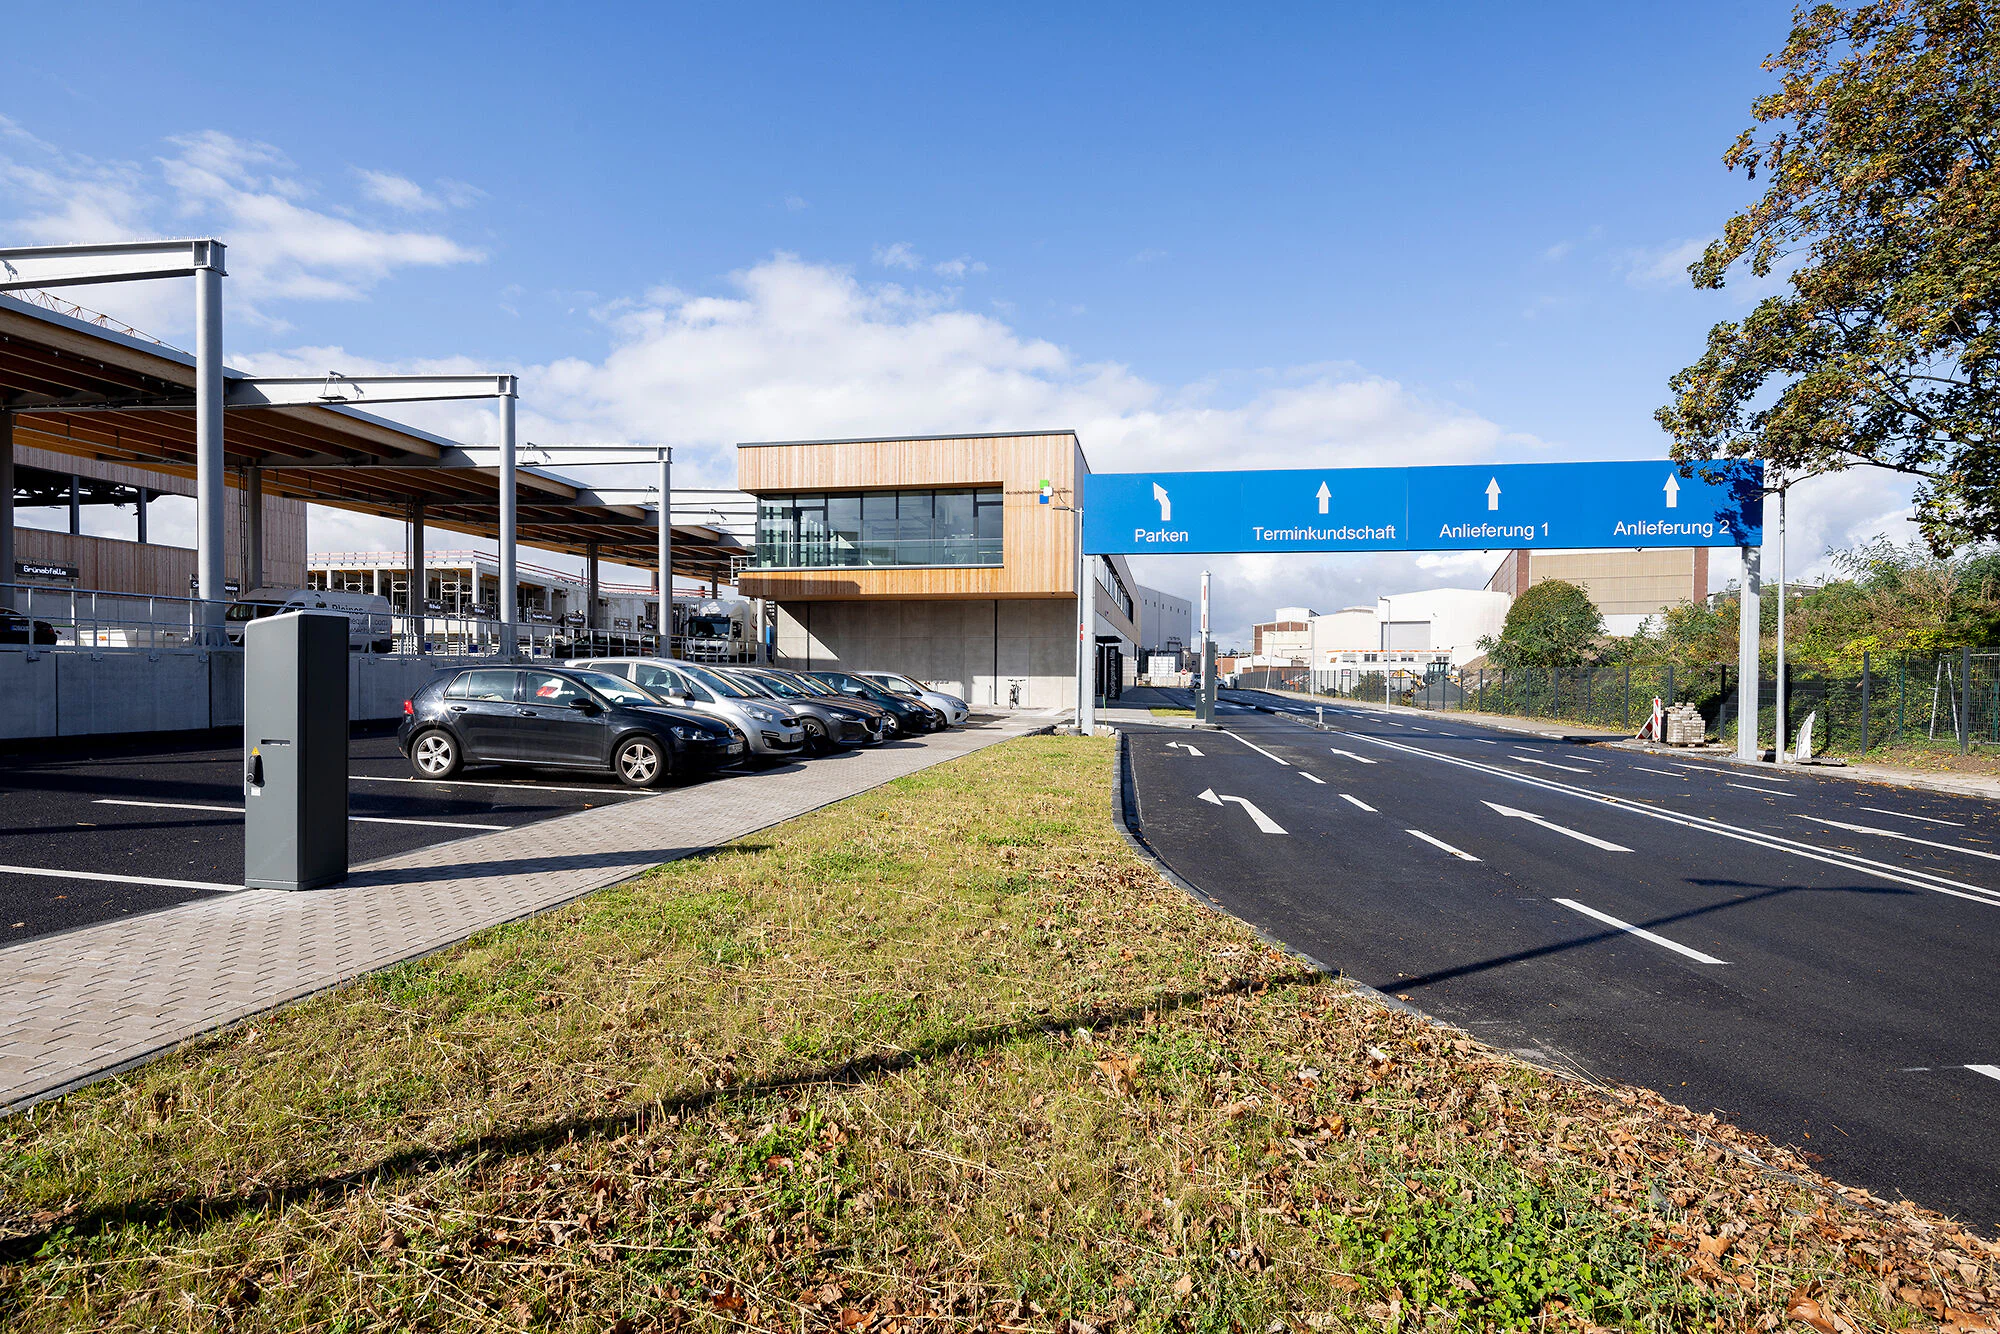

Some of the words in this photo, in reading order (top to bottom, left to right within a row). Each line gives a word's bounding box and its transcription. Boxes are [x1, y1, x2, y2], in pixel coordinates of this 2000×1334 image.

[1134, 528, 1189, 543] Parken
[1252, 525, 1396, 541] Terminkundschaft
[1439, 522, 1535, 541] Anlieferung
[1541, 521, 1548, 537] 1
[1613, 519, 1713, 538] Anlieferung
[1718, 519, 1730, 534] 2
